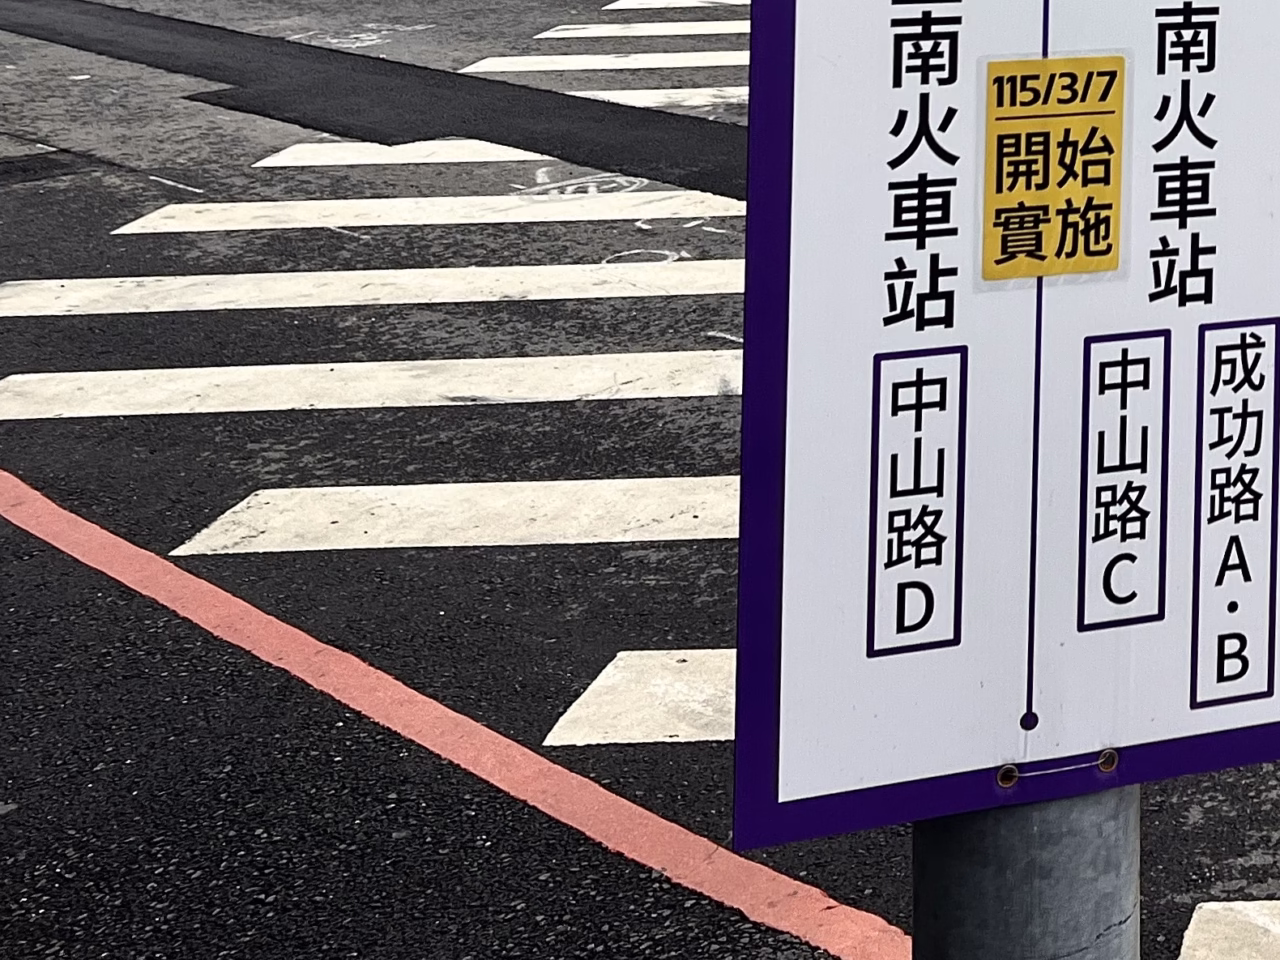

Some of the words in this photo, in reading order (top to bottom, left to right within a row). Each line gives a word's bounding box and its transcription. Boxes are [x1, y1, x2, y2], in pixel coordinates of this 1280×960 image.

[992, 70, 1118, 108] 115/3/7
[994, 125, 1116, 194] 開始
[992, 196, 1114, 266] 實施
